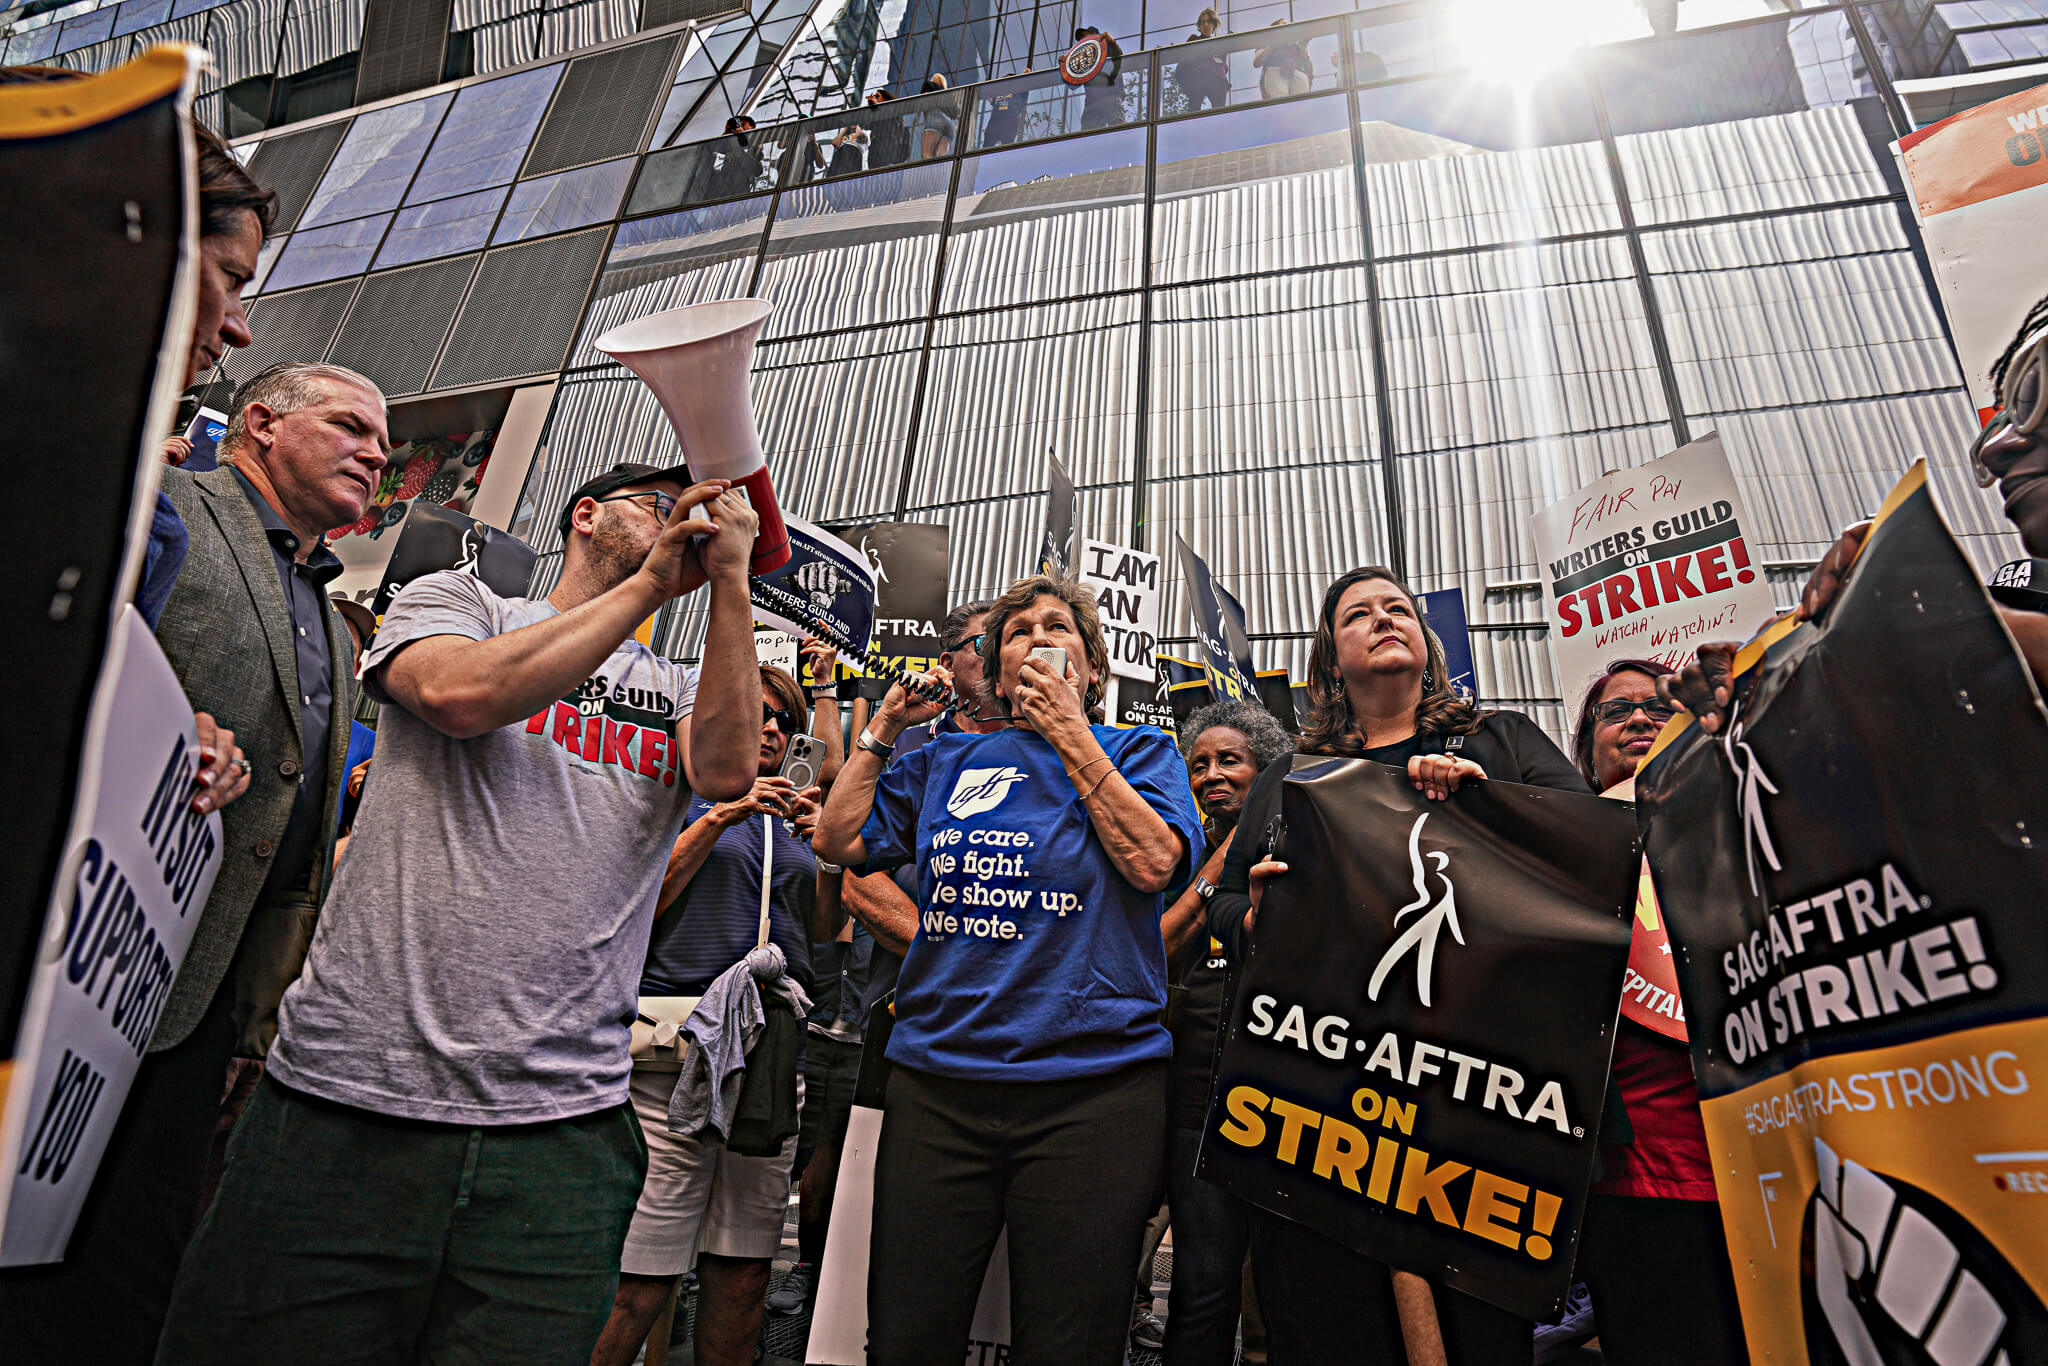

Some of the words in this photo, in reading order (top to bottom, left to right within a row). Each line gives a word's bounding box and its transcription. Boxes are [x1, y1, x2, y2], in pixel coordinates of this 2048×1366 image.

[1567, 487, 1638, 544] FAIR
[802, 543, 817, 553] AFT
[814, 549, 834, 565] strong
[1550, 526, 1646, 580] WRITERS
[1652, 500, 1733, 541] GUILD
[1623, 549, 1649, 567] ON
[1086, 546, 1114, 581] I
[1110, 553, 1159, 591] AM
[1557, 536, 1756, 638] STRIKE!
[808, 604, 835, 623] GUILD
[835, 618, 850, 635] AND
[1096, 586, 1142, 624] AN
[755, 637, 773, 646] no
[579, 698, 605, 716] ON
[613, 683, 674, 720] GUILD
[1124, 710, 1146, 724] ON
[1148, 714, 1175, 728] STR
[141, 732, 215, 918] NYSUT
[932, 827, 963, 850] We
[968, 829, 1035, 848] care.
[930, 852, 957, 879] We
[962, 850, 1030, 880] fight.
[962, 881, 1033, 909] show
[1040, 891, 1083, 917] up.
[923, 910, 959, 934] We
[962, 914, 1024, 941] vote.
[1724, 999, 1769, 1065] ON
[1767, 916, 1998, 1045] STRIKE!
[1351, 1087, 1418, 1136] ON
[1745, 1050, 2030, 1137] #SAGAFTRASTRONG
[19, 1048, 106, 1185] YOU
[1218, 1085, 1563, 1261] STRIKE!
